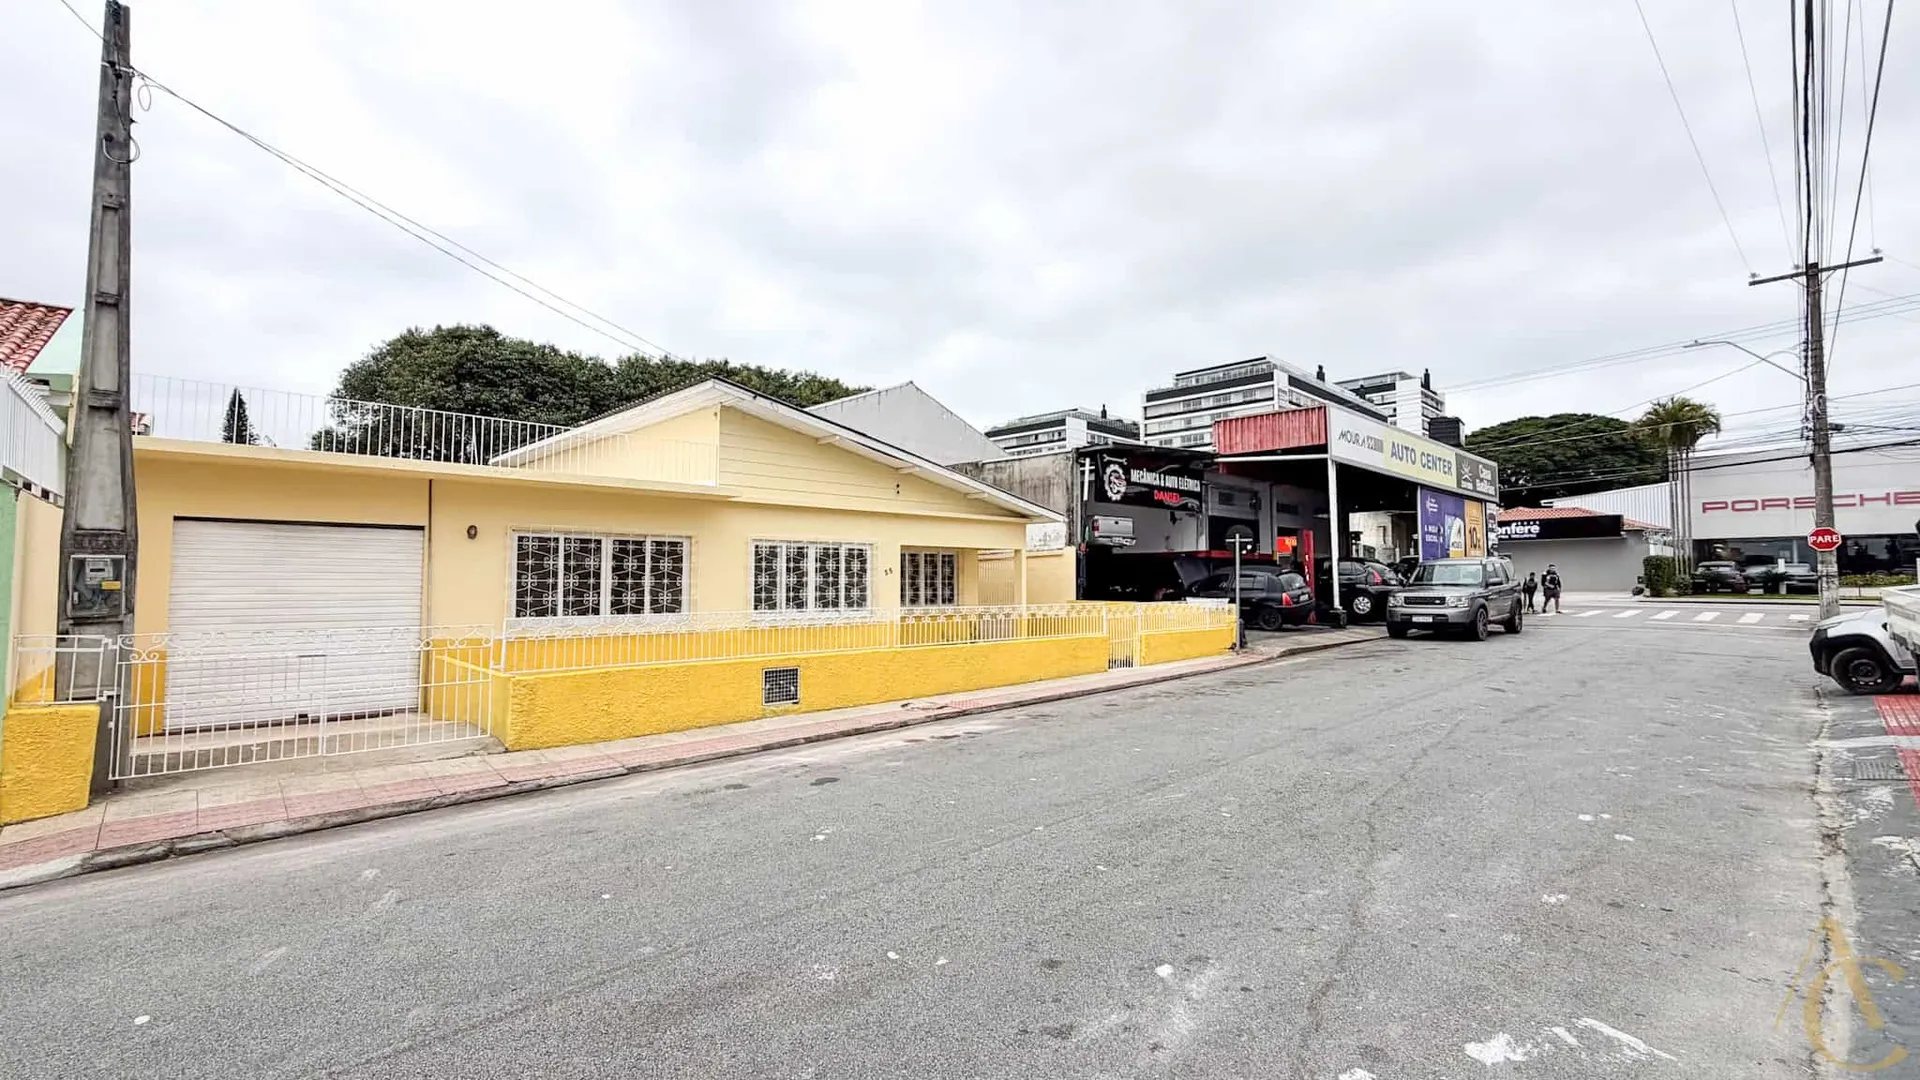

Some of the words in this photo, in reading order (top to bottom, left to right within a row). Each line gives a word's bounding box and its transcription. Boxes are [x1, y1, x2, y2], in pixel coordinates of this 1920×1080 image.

[1391, 441, 1416, 466] AUTO
[1420, 451, 1453, 476] CENTER
[1130, 468, 1160, 486] MECÂNICA
[1166, 474, 1178, 489] AUTO
[1178, 475, 1201, 492] ELÉTRICA
[1701, 490, 1920, 514] PORSCHE
[1809, 534, 1840, 546] PARE
